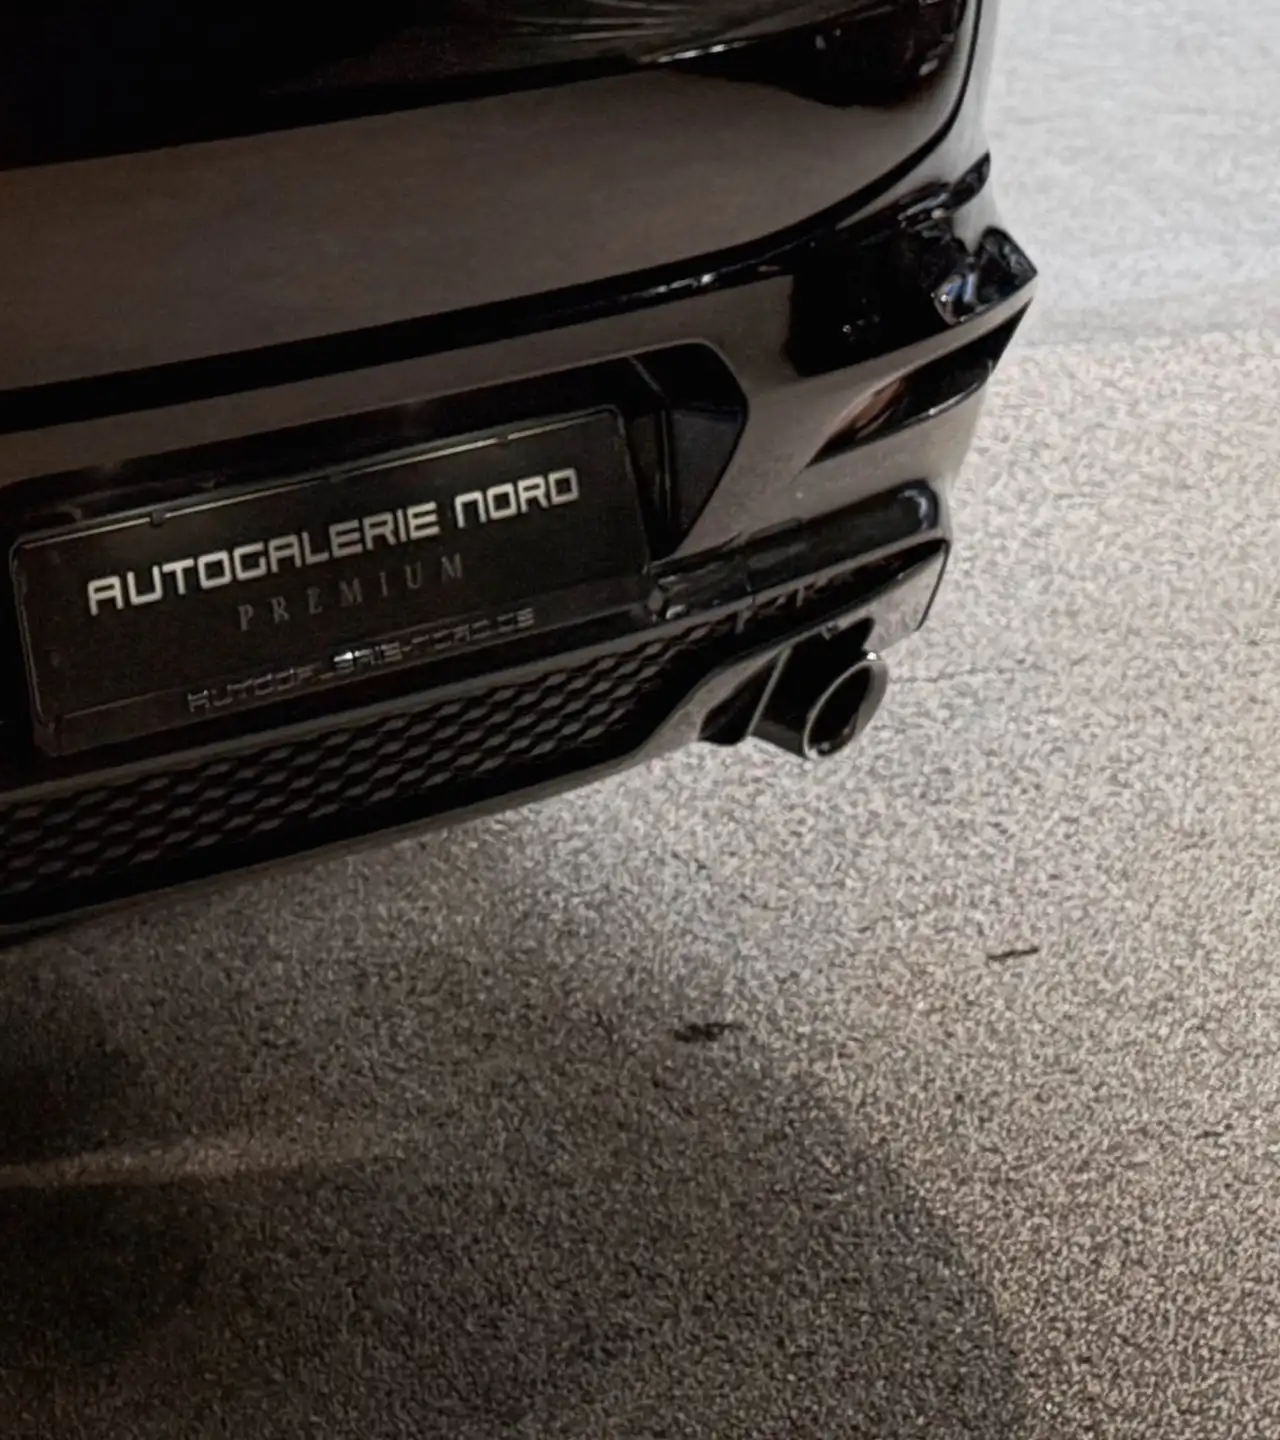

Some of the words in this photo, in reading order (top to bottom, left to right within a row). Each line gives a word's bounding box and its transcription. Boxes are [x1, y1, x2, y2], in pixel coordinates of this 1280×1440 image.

[86, 500, 440, 616] AUTOGALERIE
[453, 467, 580, 529] NORD
[237, 553, 466, 632] PREMIUM
